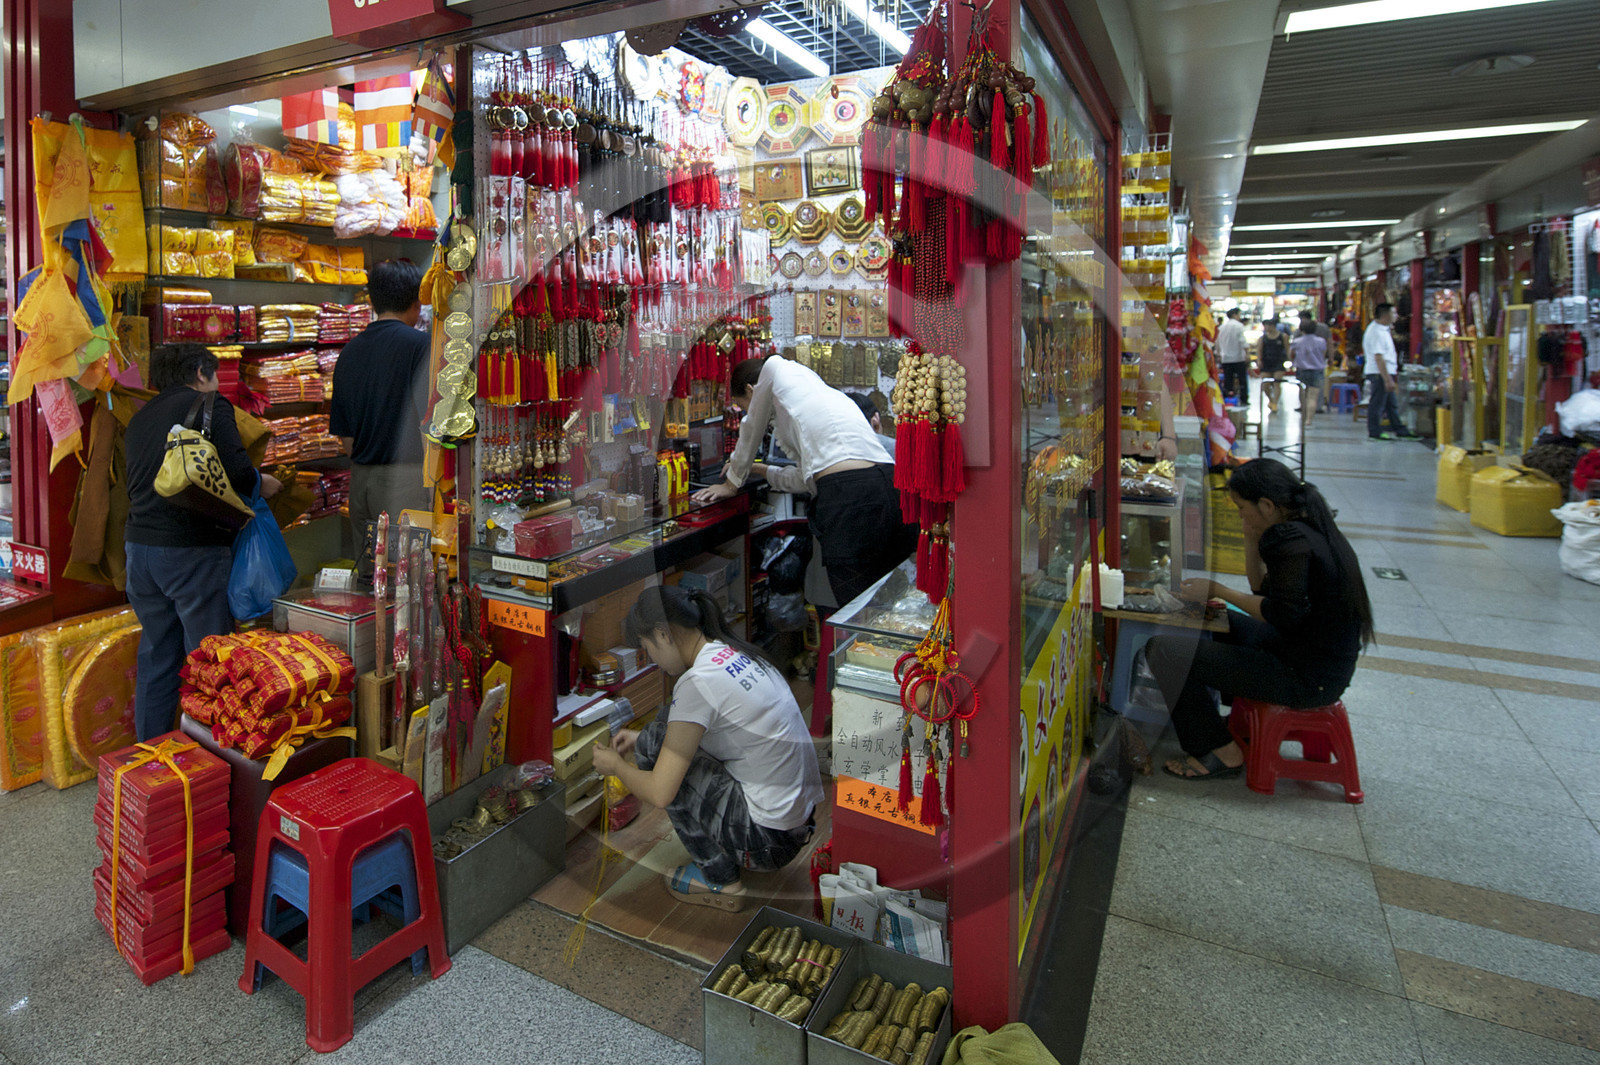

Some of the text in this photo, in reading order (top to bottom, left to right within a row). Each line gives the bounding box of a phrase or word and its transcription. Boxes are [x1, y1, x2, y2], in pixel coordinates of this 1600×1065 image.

[14, 549, 45, 575] 灭火器
[725, 654, 753, 679] FAVO
[739, 671, 759, 692] BY
[837, 907, 865, 932] 日报
